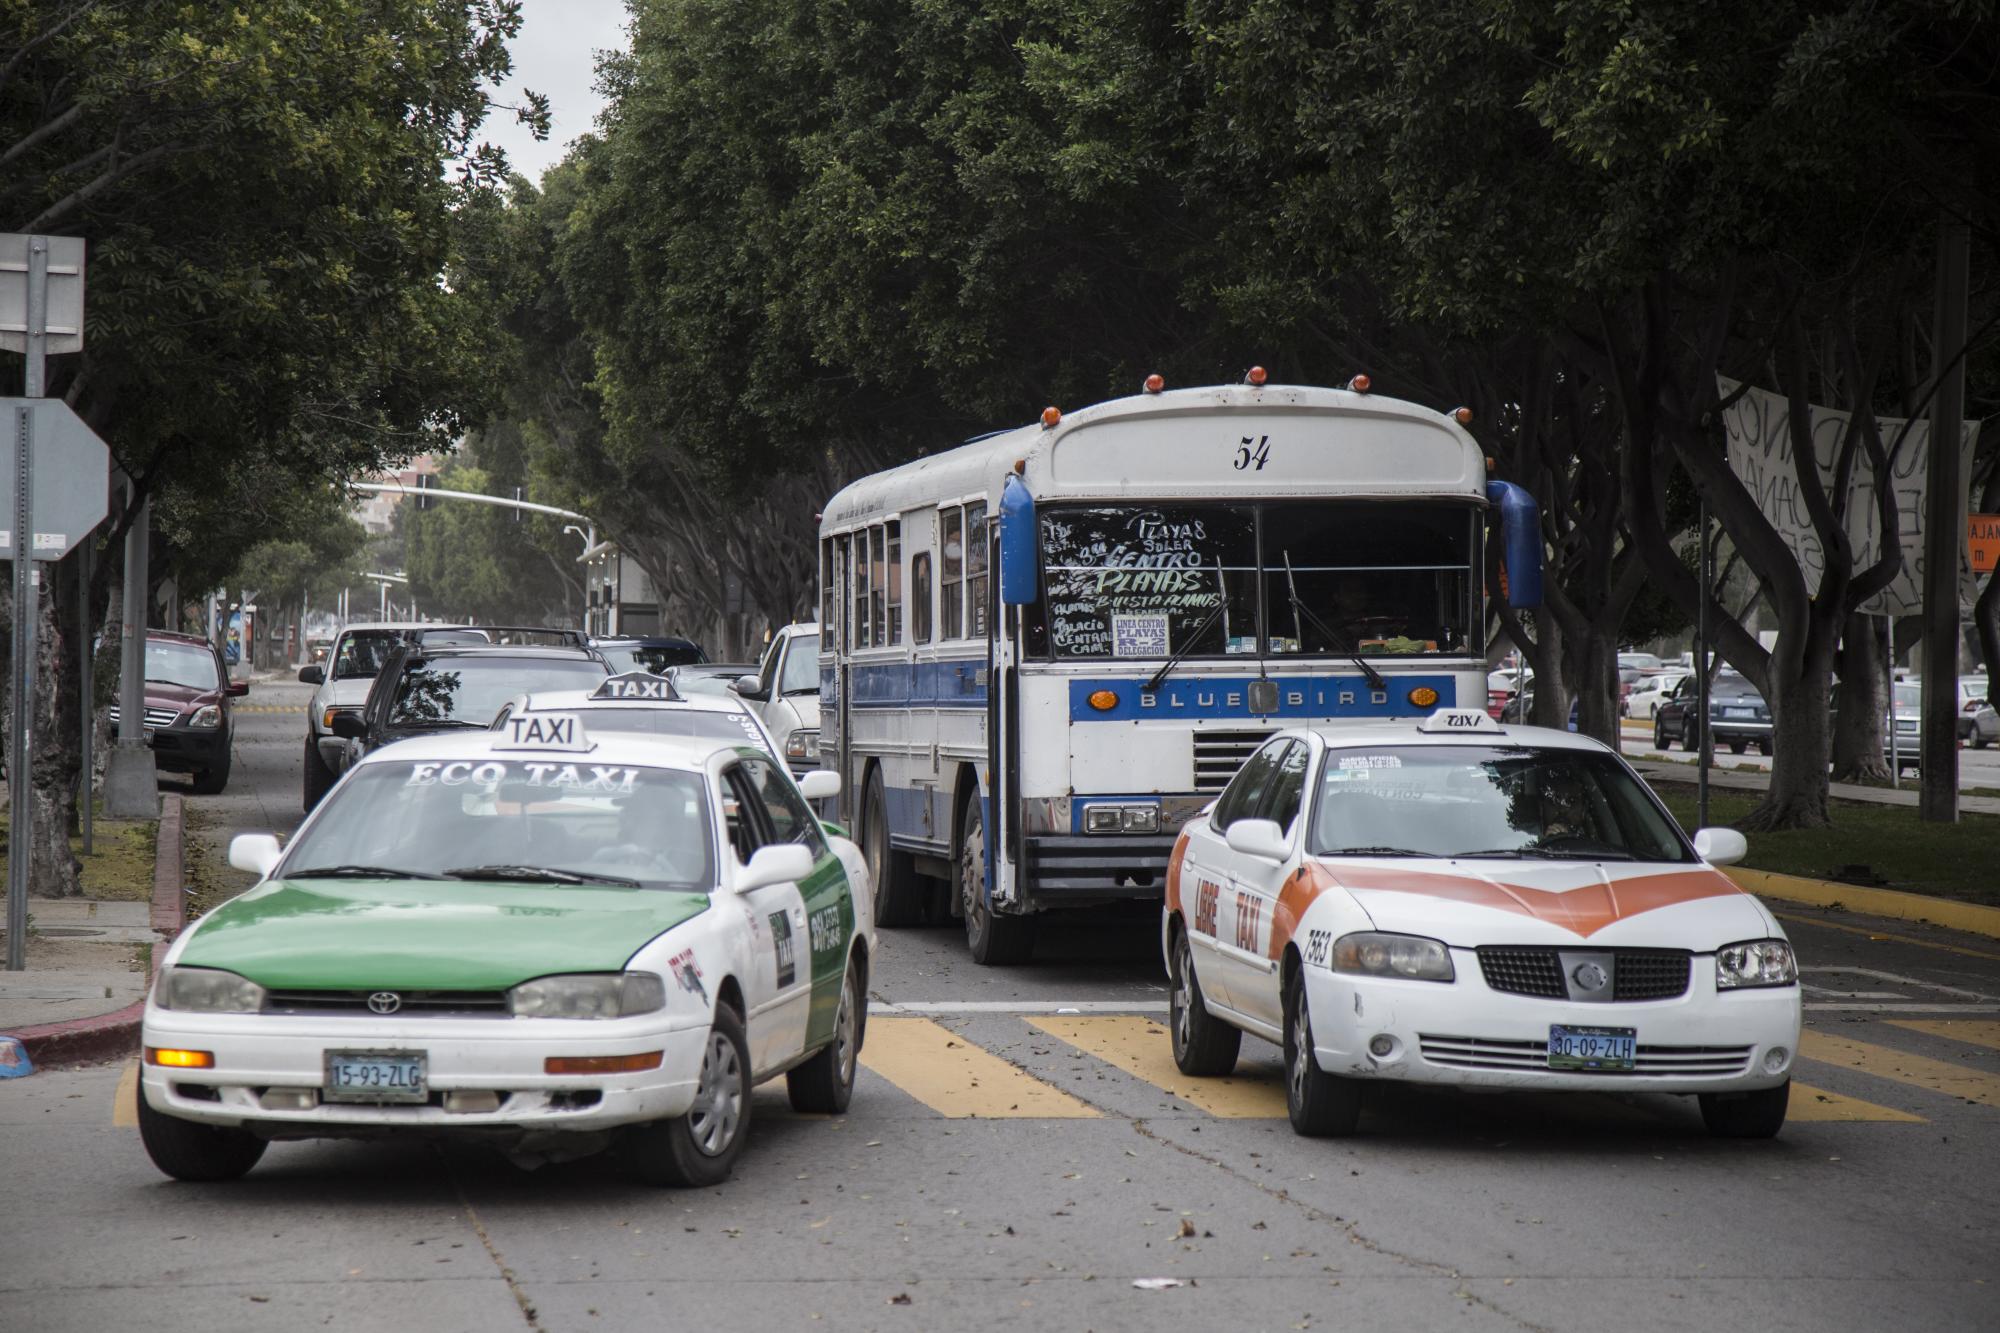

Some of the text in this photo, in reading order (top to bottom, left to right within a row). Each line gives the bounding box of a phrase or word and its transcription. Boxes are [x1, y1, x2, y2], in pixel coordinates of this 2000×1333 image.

[1234, 435, 1271, 471] 54
[1143, 539, 1193, 553] SOLER
[1095, 569, 1203, 594] PLAYAS
[1117, 619, 1165, 628] LINEA CENTRO
[1117, 629, 1165, 637] PLAYAS
[1118, 637, 1165, 646] R-2
[1119, 646, 1165, 655] DELEGACION
[607, 680, 668, 698] TAXI
[1140, 691, 1388, 707] BLUE BIRD
[509, 718, 573, 744] TAXI
[405, 762, 640, 793] ECO TAXI
[1195, 877, 1220, 938] LIBRE
[1236, 891, 1263, 954] TAXI
[1304, 929, 1332, 964] 7563
[334, 1065, 419, 1087] 15-93-ZLG
